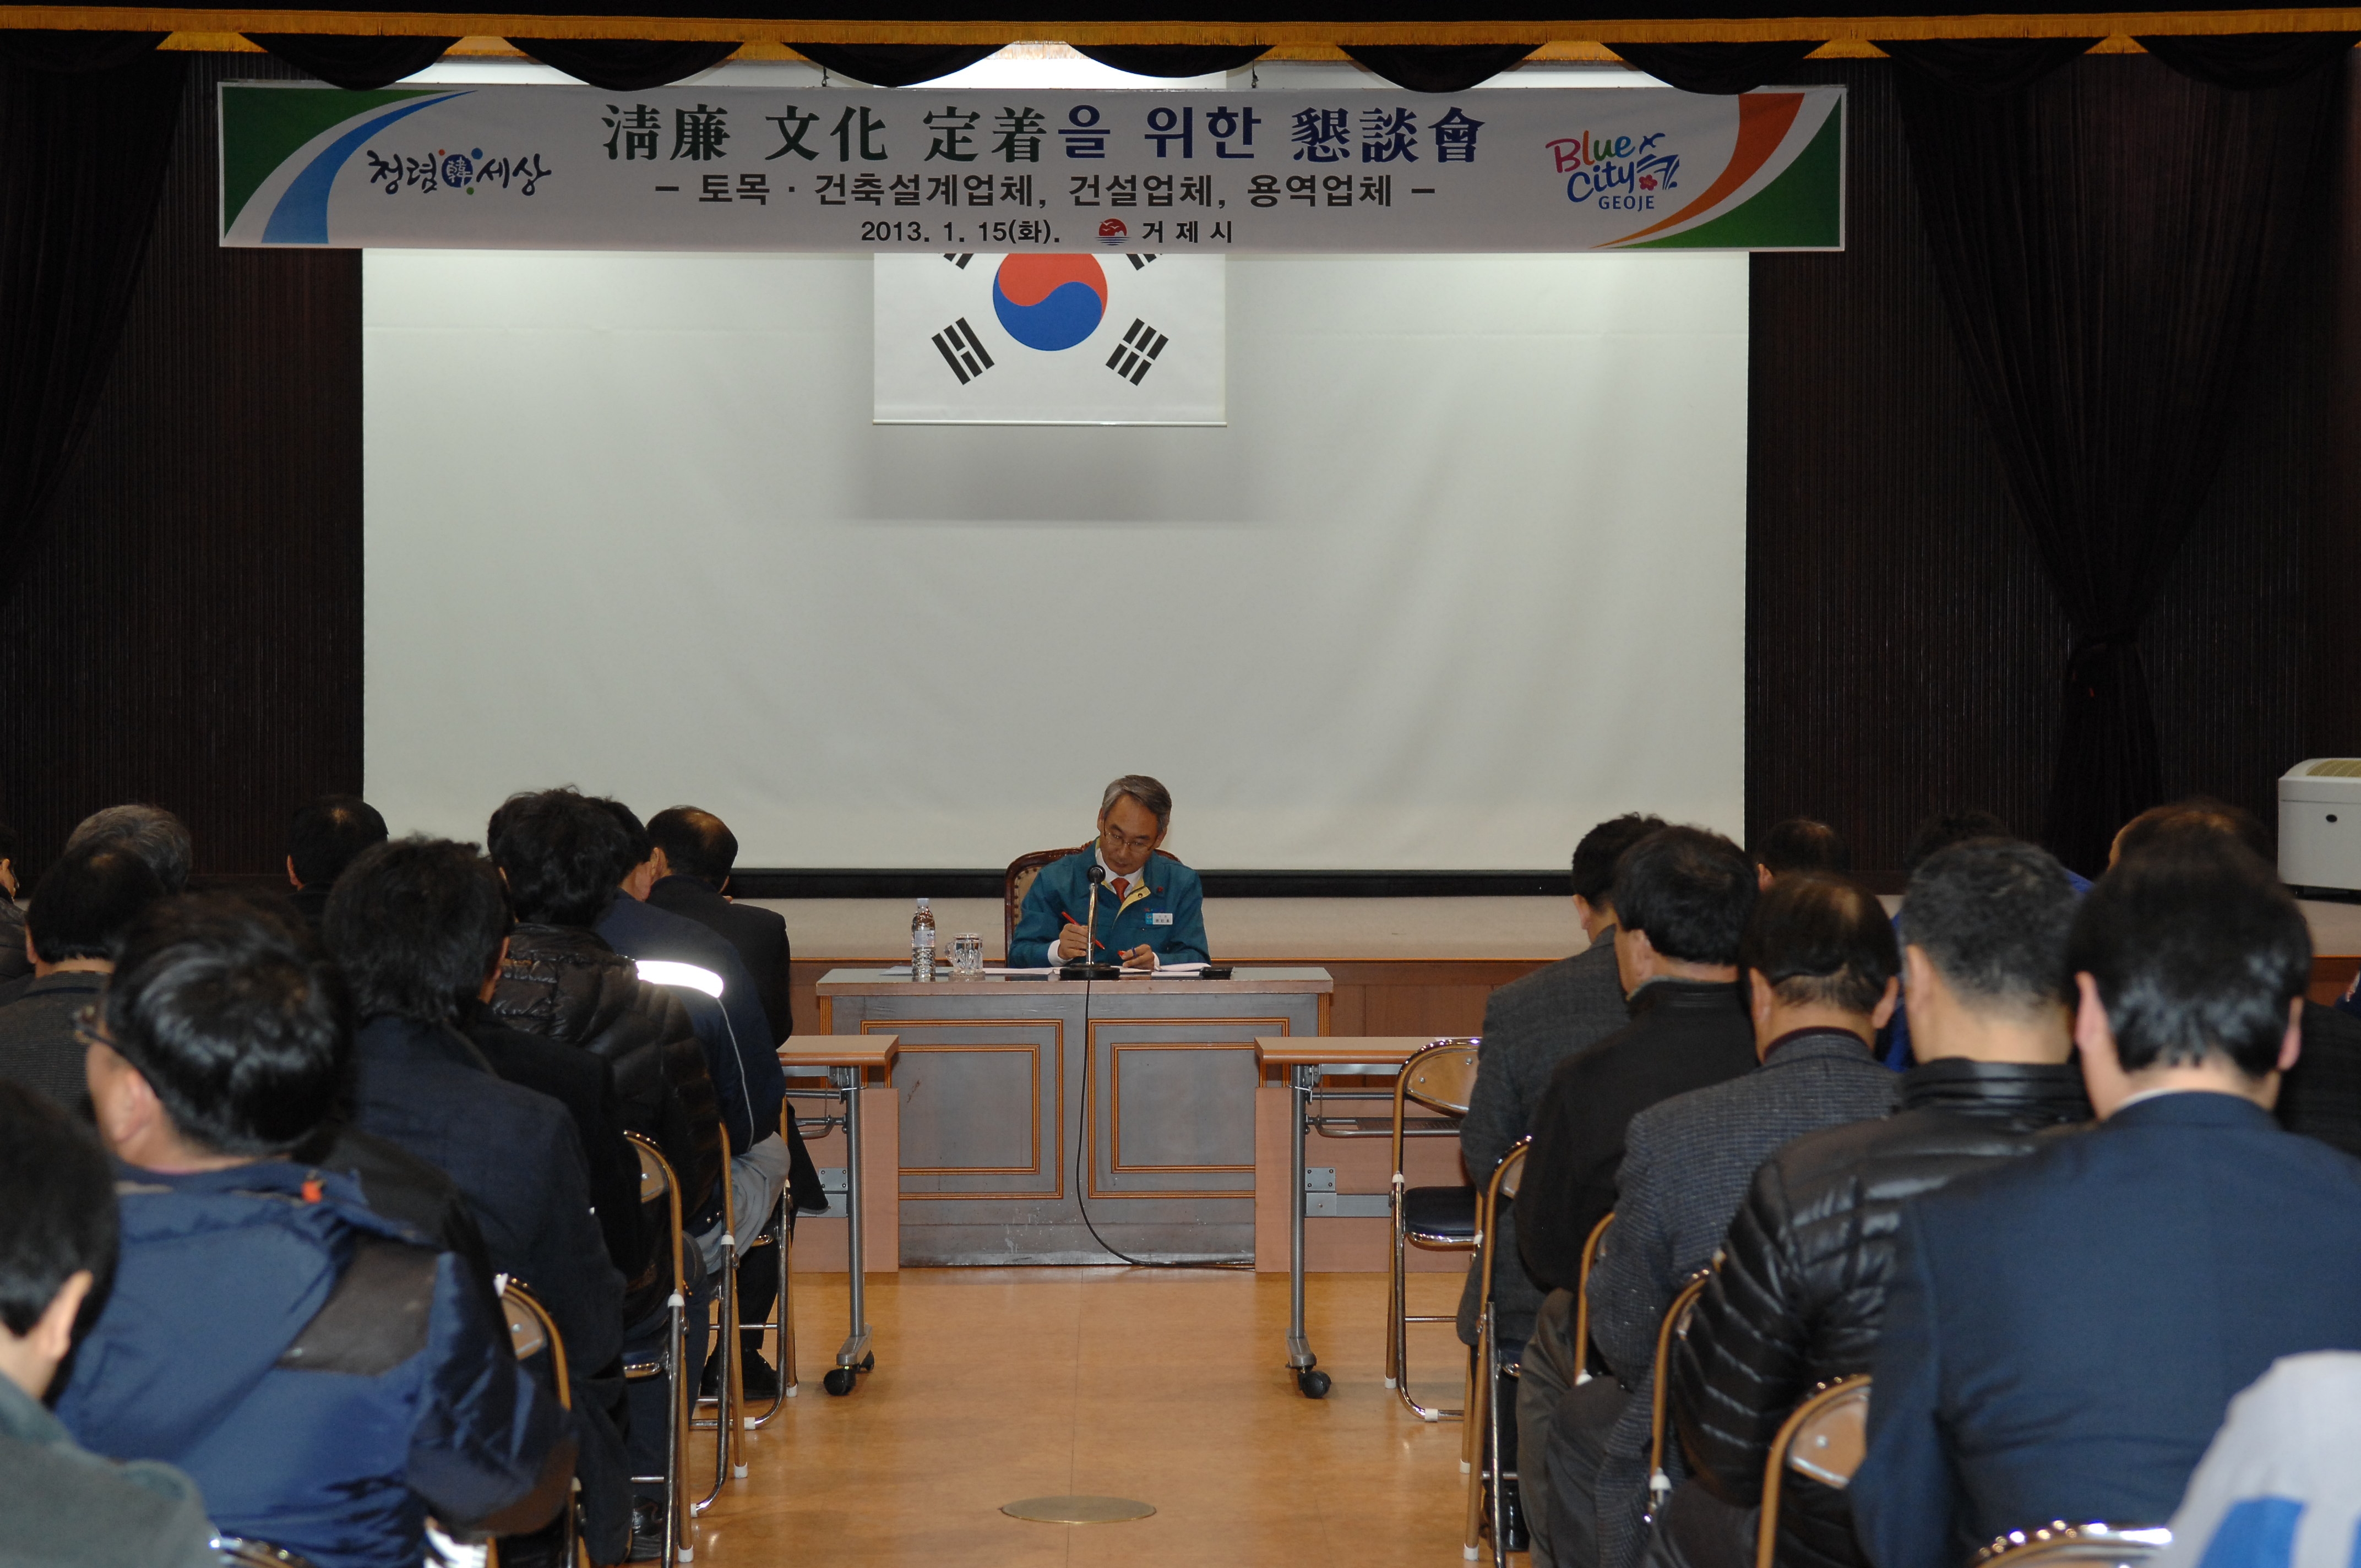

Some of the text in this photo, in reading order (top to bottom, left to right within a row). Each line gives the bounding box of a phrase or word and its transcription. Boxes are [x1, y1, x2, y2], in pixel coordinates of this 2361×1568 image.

[765, 105, 889, 163] 文化
[923, 105, 1111, 164] 定着을
[1144, 106, 1262, 159] 위한
[1291, 106, 1486, 164] 懇談會
[1545, 130, 1636, 173] Blue
[699, 173, 771, 206] 토목
[815, 173, 1047, 209] 건축설계업체,
[1069, 175, 1226, 210] 건설업체,
[1247, 175, 1392, 208] 용역업체
[1566, 160, 1636, 203] City
[1598, 195, 1655, 213] GEOJE
[861, 219, 1060, 245] 2013. 1. 15(화).
